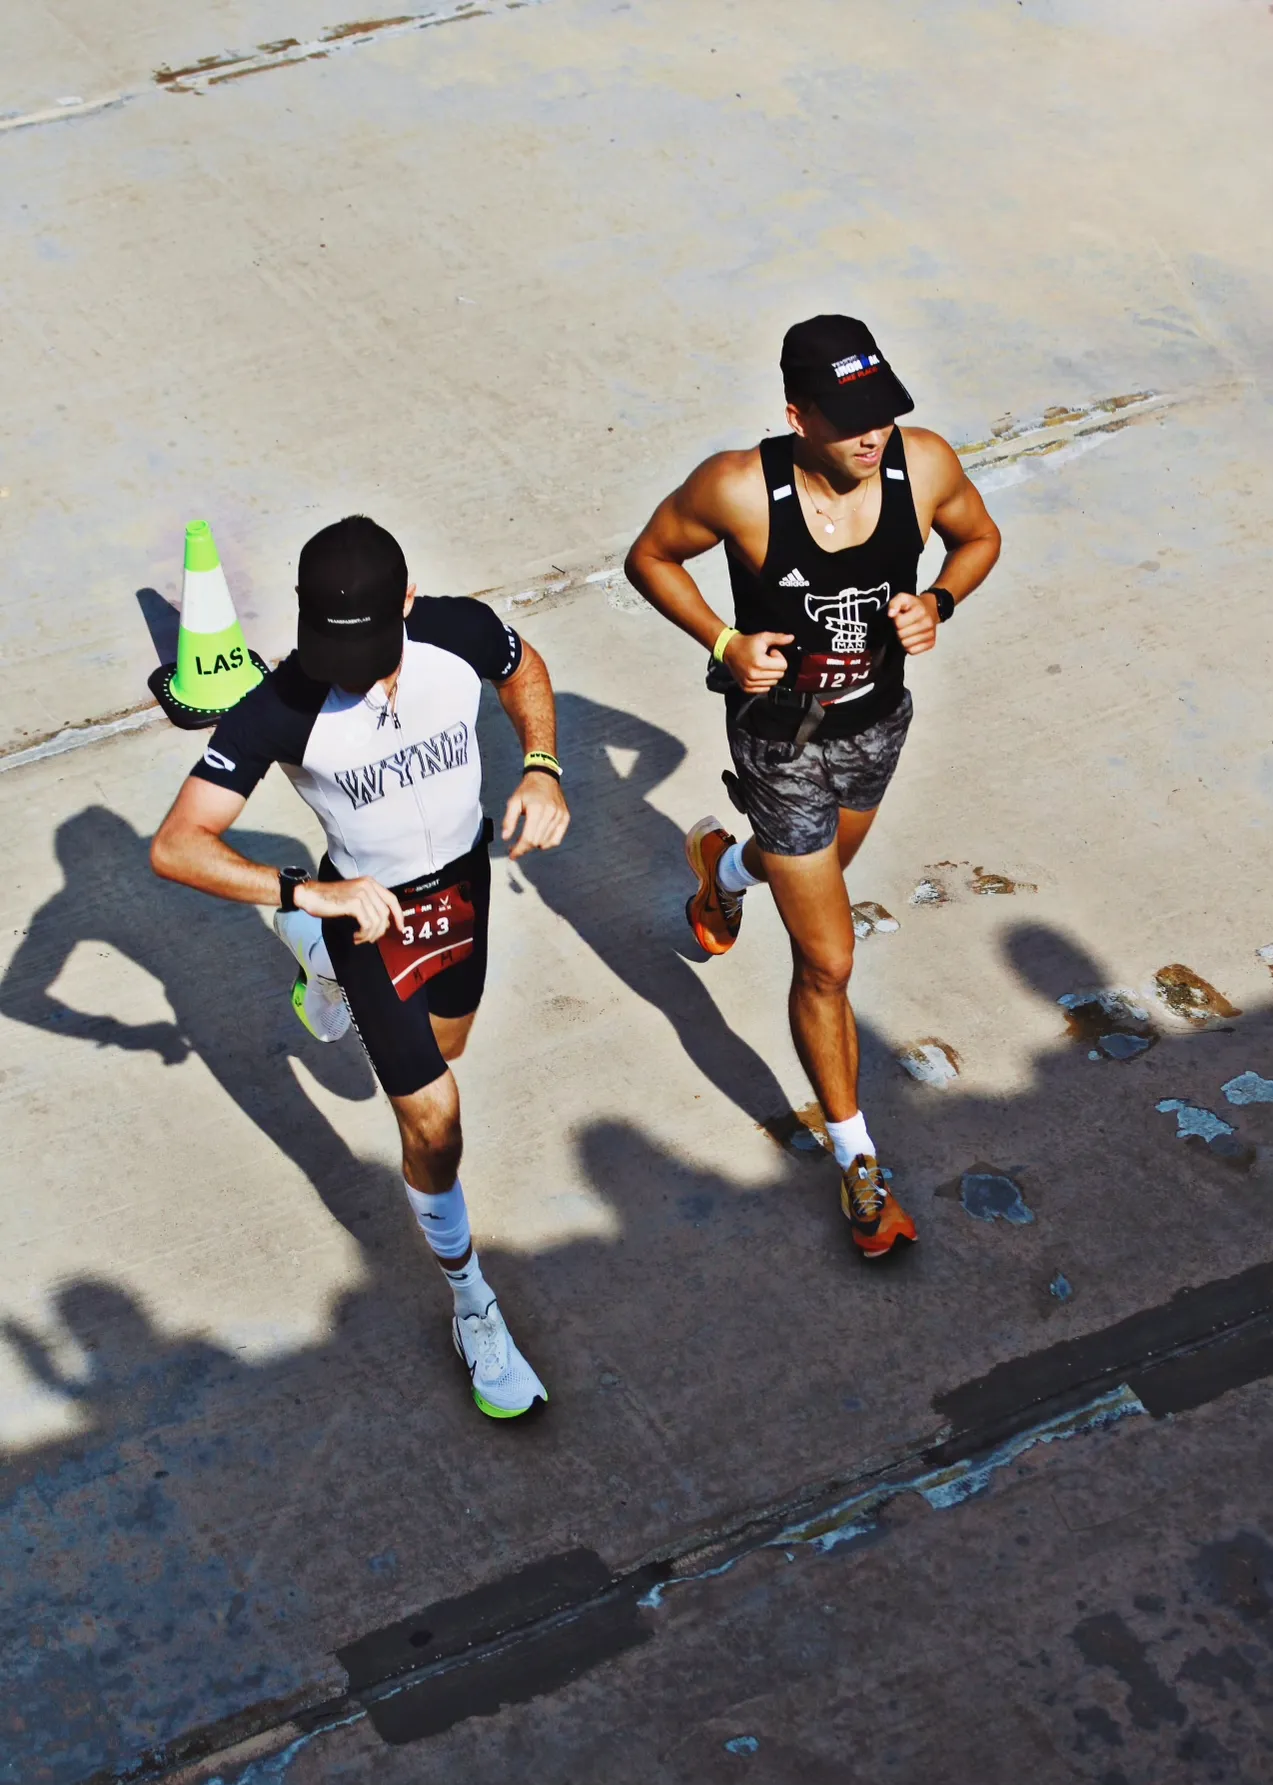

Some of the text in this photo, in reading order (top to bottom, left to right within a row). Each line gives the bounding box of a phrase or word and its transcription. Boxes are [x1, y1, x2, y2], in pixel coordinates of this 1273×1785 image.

[837, 621, 863, 634] TIN
[836, 641, 863, 650] MAN
[195, 647, 244, 676] LAS
[402, 917, 449, 946] 343
